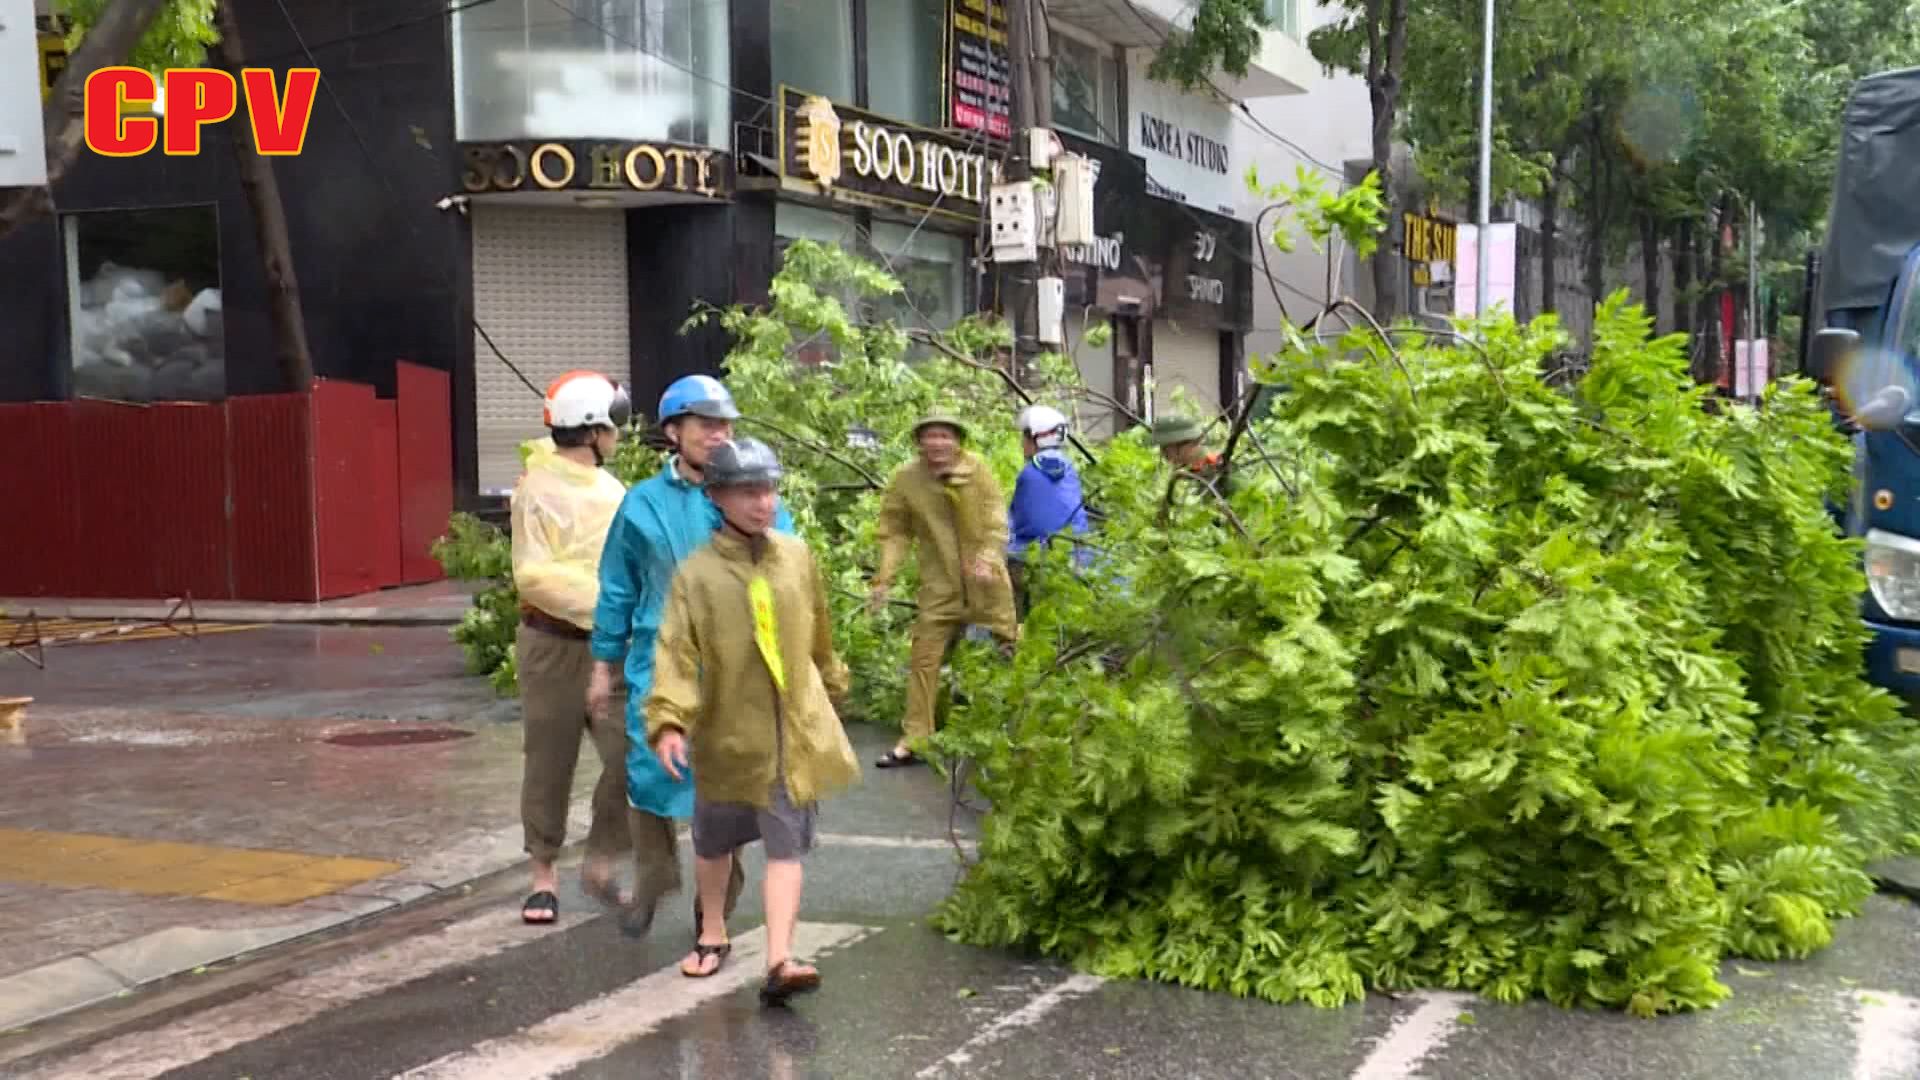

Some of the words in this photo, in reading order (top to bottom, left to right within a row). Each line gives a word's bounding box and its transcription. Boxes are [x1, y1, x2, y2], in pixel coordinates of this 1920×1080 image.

[853, 120, 915, 184] SOO
[1141, 112, 1182, 160] KOREA
[1187, 132, 1229, 175] STUDIO
[1404, 212, 1431, 261] THE
[1432, 222, 1457, 262] SU
